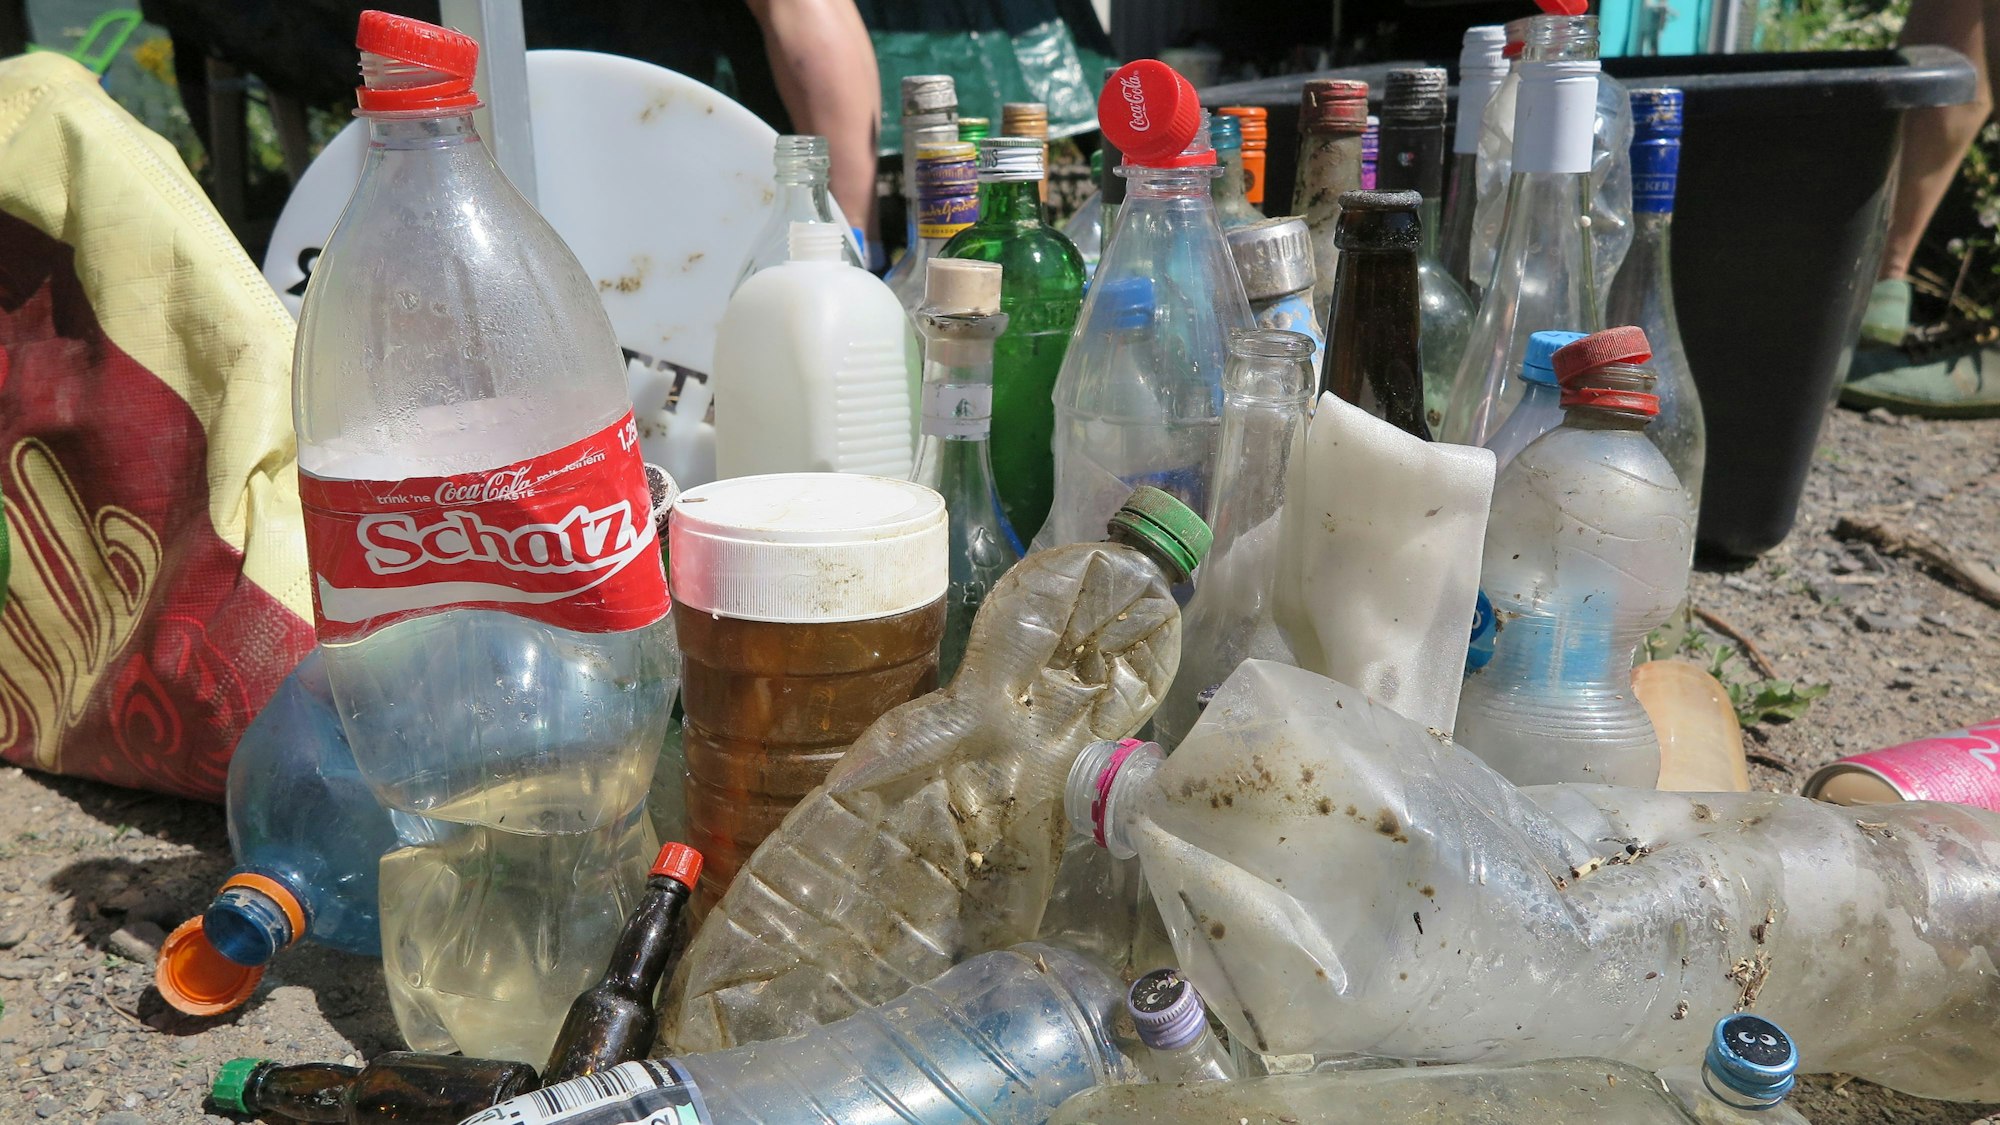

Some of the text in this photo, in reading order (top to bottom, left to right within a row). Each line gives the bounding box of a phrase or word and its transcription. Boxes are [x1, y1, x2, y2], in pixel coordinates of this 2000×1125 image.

[1119, 75, 1150, 132] Coca-Cola
[377, 495, 408, 505] trink
[410, 495, 431, 503] 'ne
[434, 462, 534, 508] Coca-Cola
[503, 488, 535, 501] ASTE
[356, 500, 640, 576] Schatz
